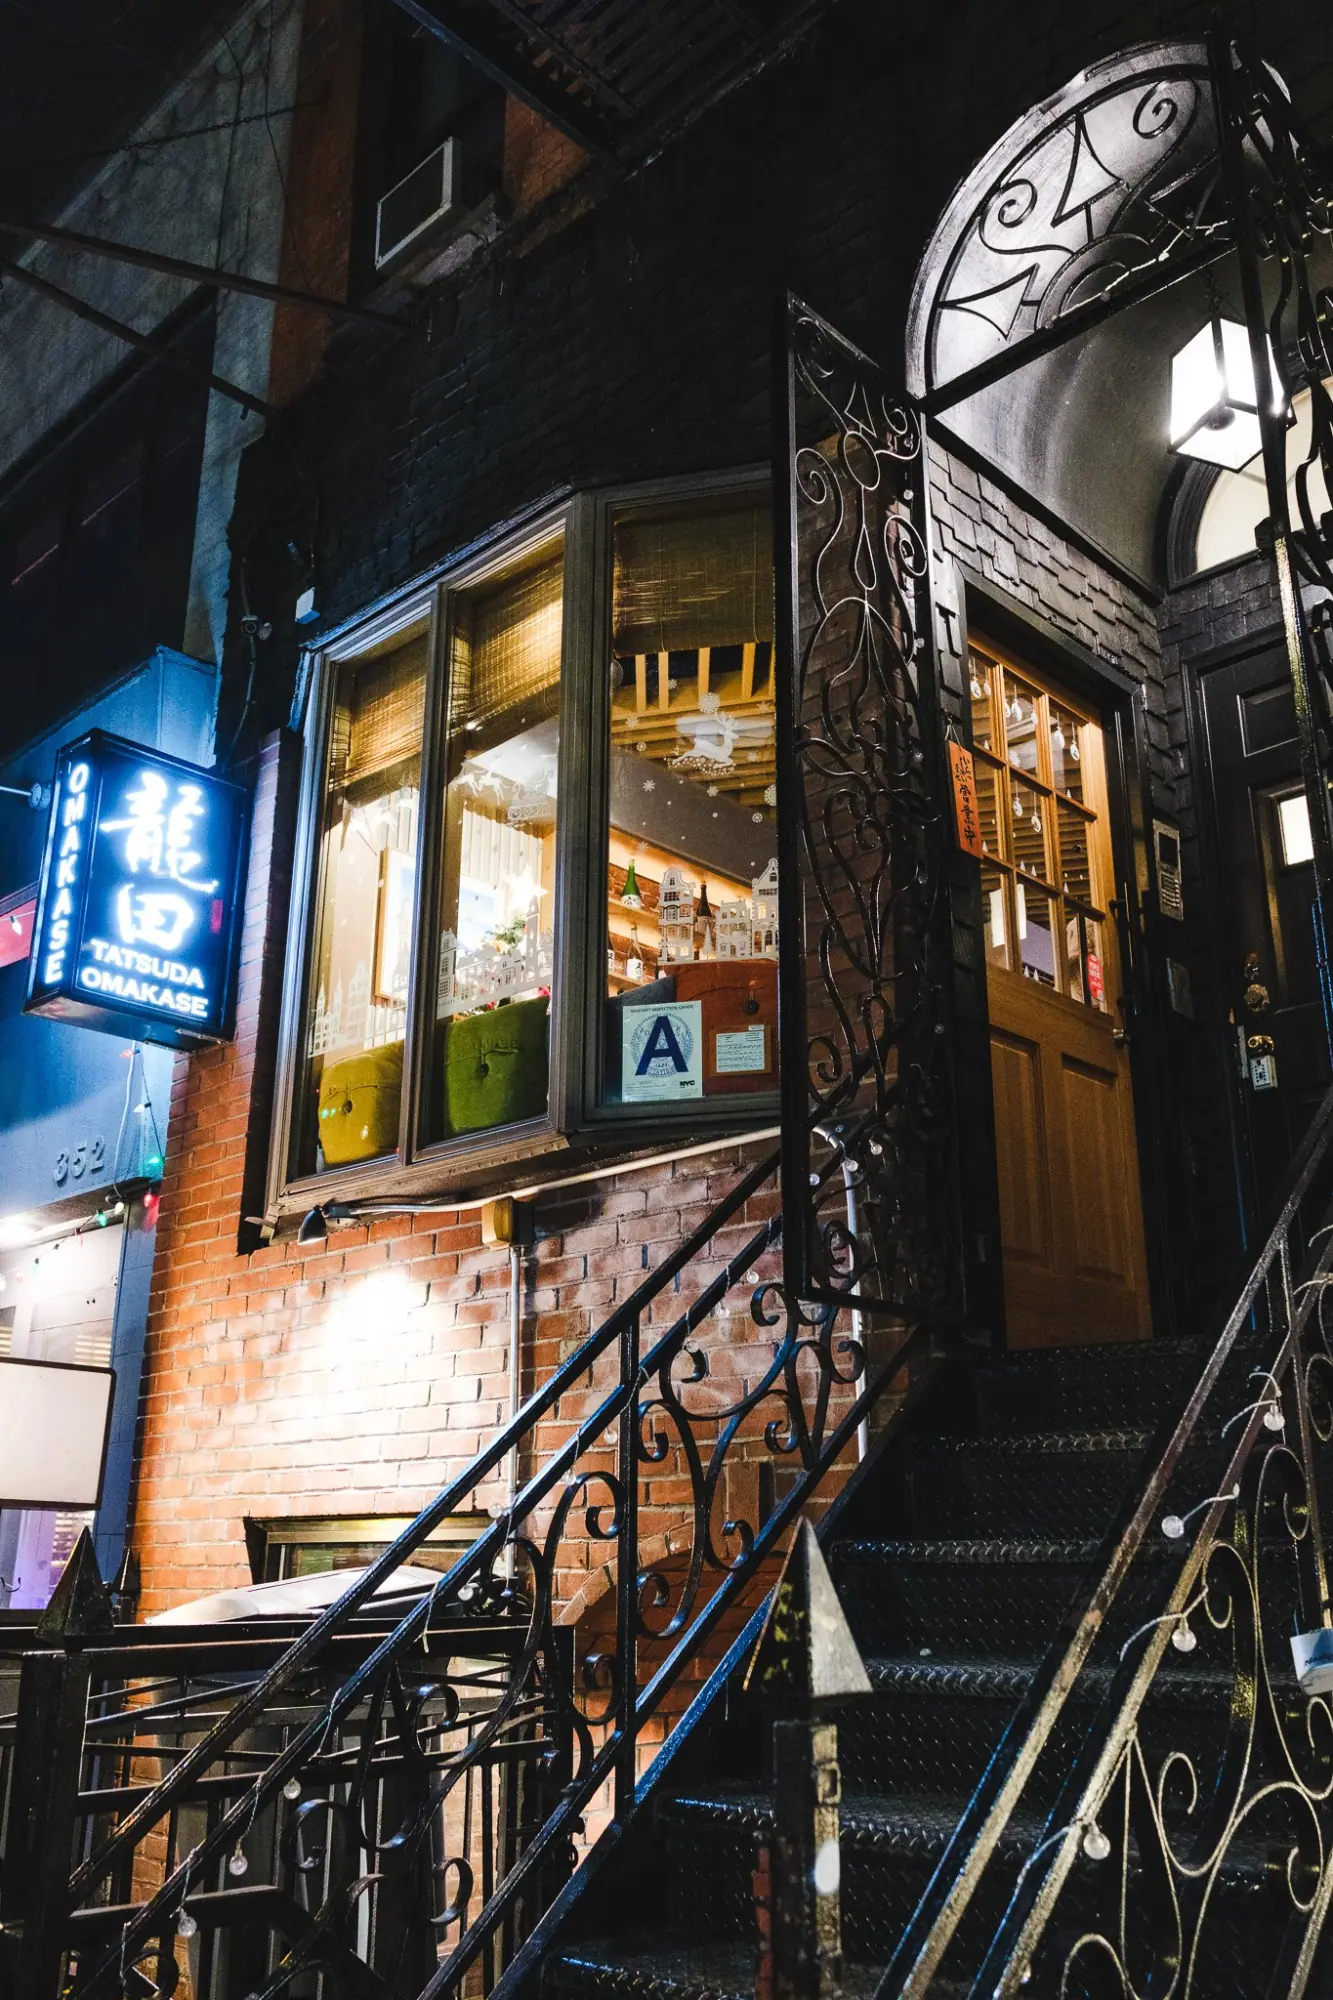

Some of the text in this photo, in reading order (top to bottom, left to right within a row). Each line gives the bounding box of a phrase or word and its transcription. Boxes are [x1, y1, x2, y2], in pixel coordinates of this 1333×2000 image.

[45, 763, 89, 984] OMAKASE
[91, 939, 205, 989] TATSUDA
[81, 967, 208, 1018] OMAKASE
[635, 1016, 689, 1076] A
[54, 1135, 105, 1187] 352
